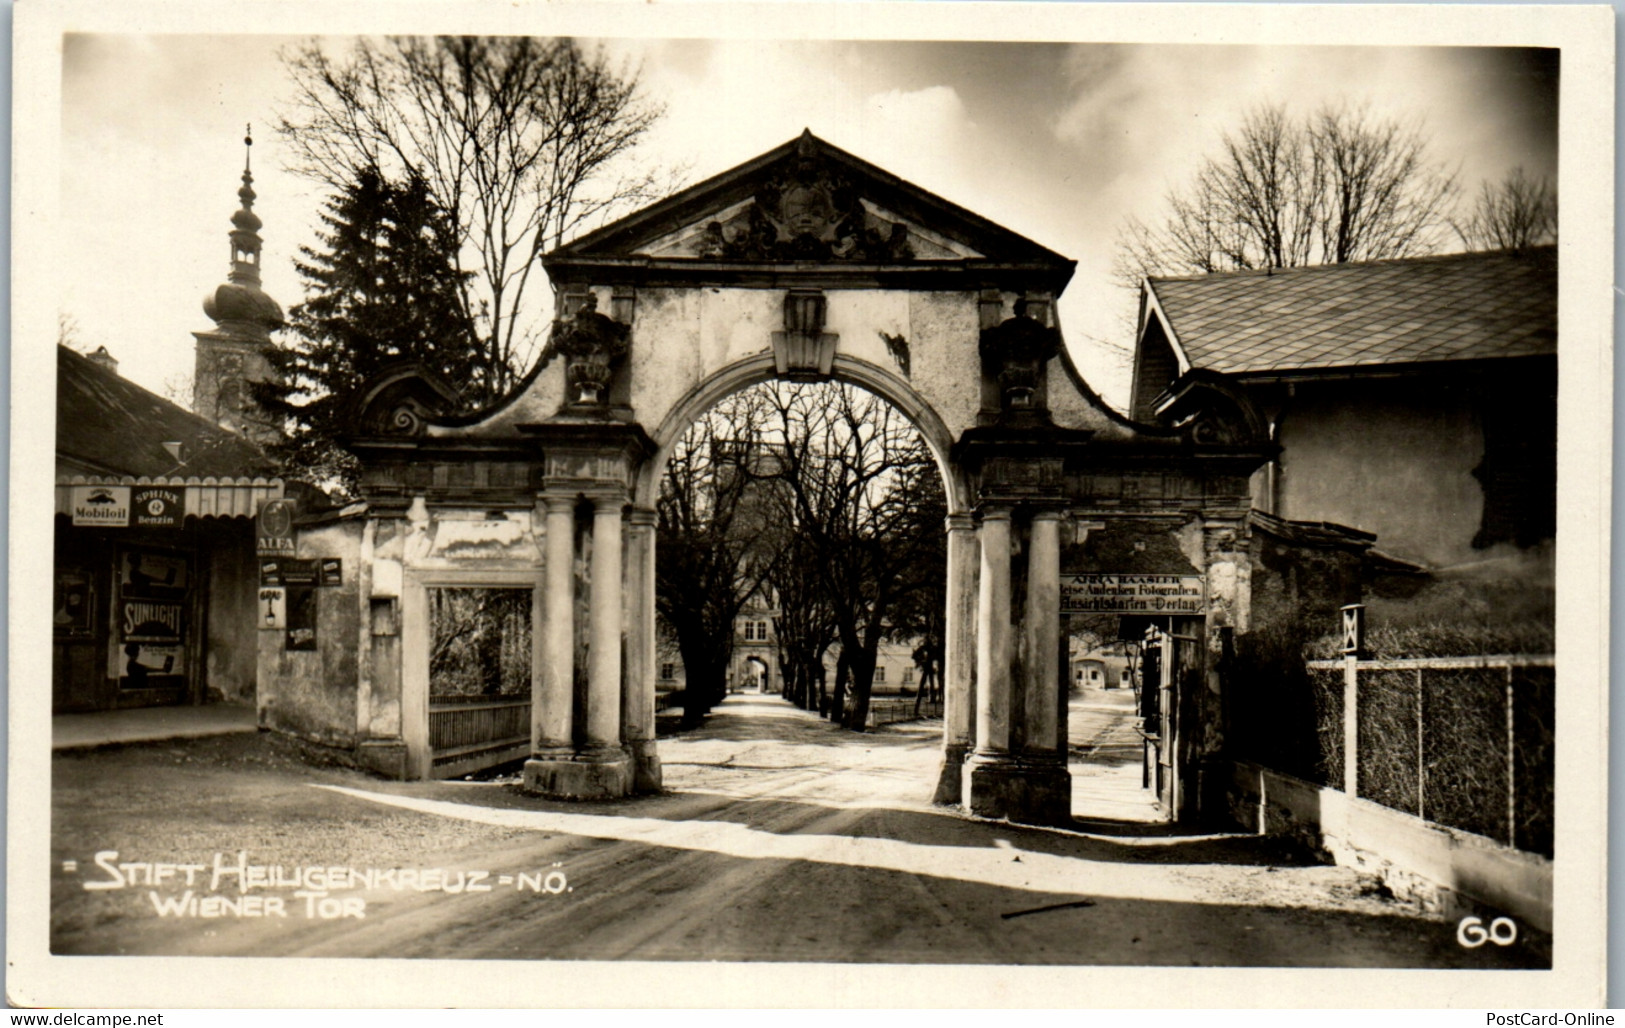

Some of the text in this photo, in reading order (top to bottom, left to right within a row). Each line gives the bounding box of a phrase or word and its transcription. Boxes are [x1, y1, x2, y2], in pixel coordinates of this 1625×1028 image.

[75, 507, 126, 519] Mobiloil
[138, 515, 174, 525] Benzin
[256, 537, 294, 549] ALFA
[1085, 583, 1136, 596] Andenken
[124, 602, 182, 635] SUNLIGHT
